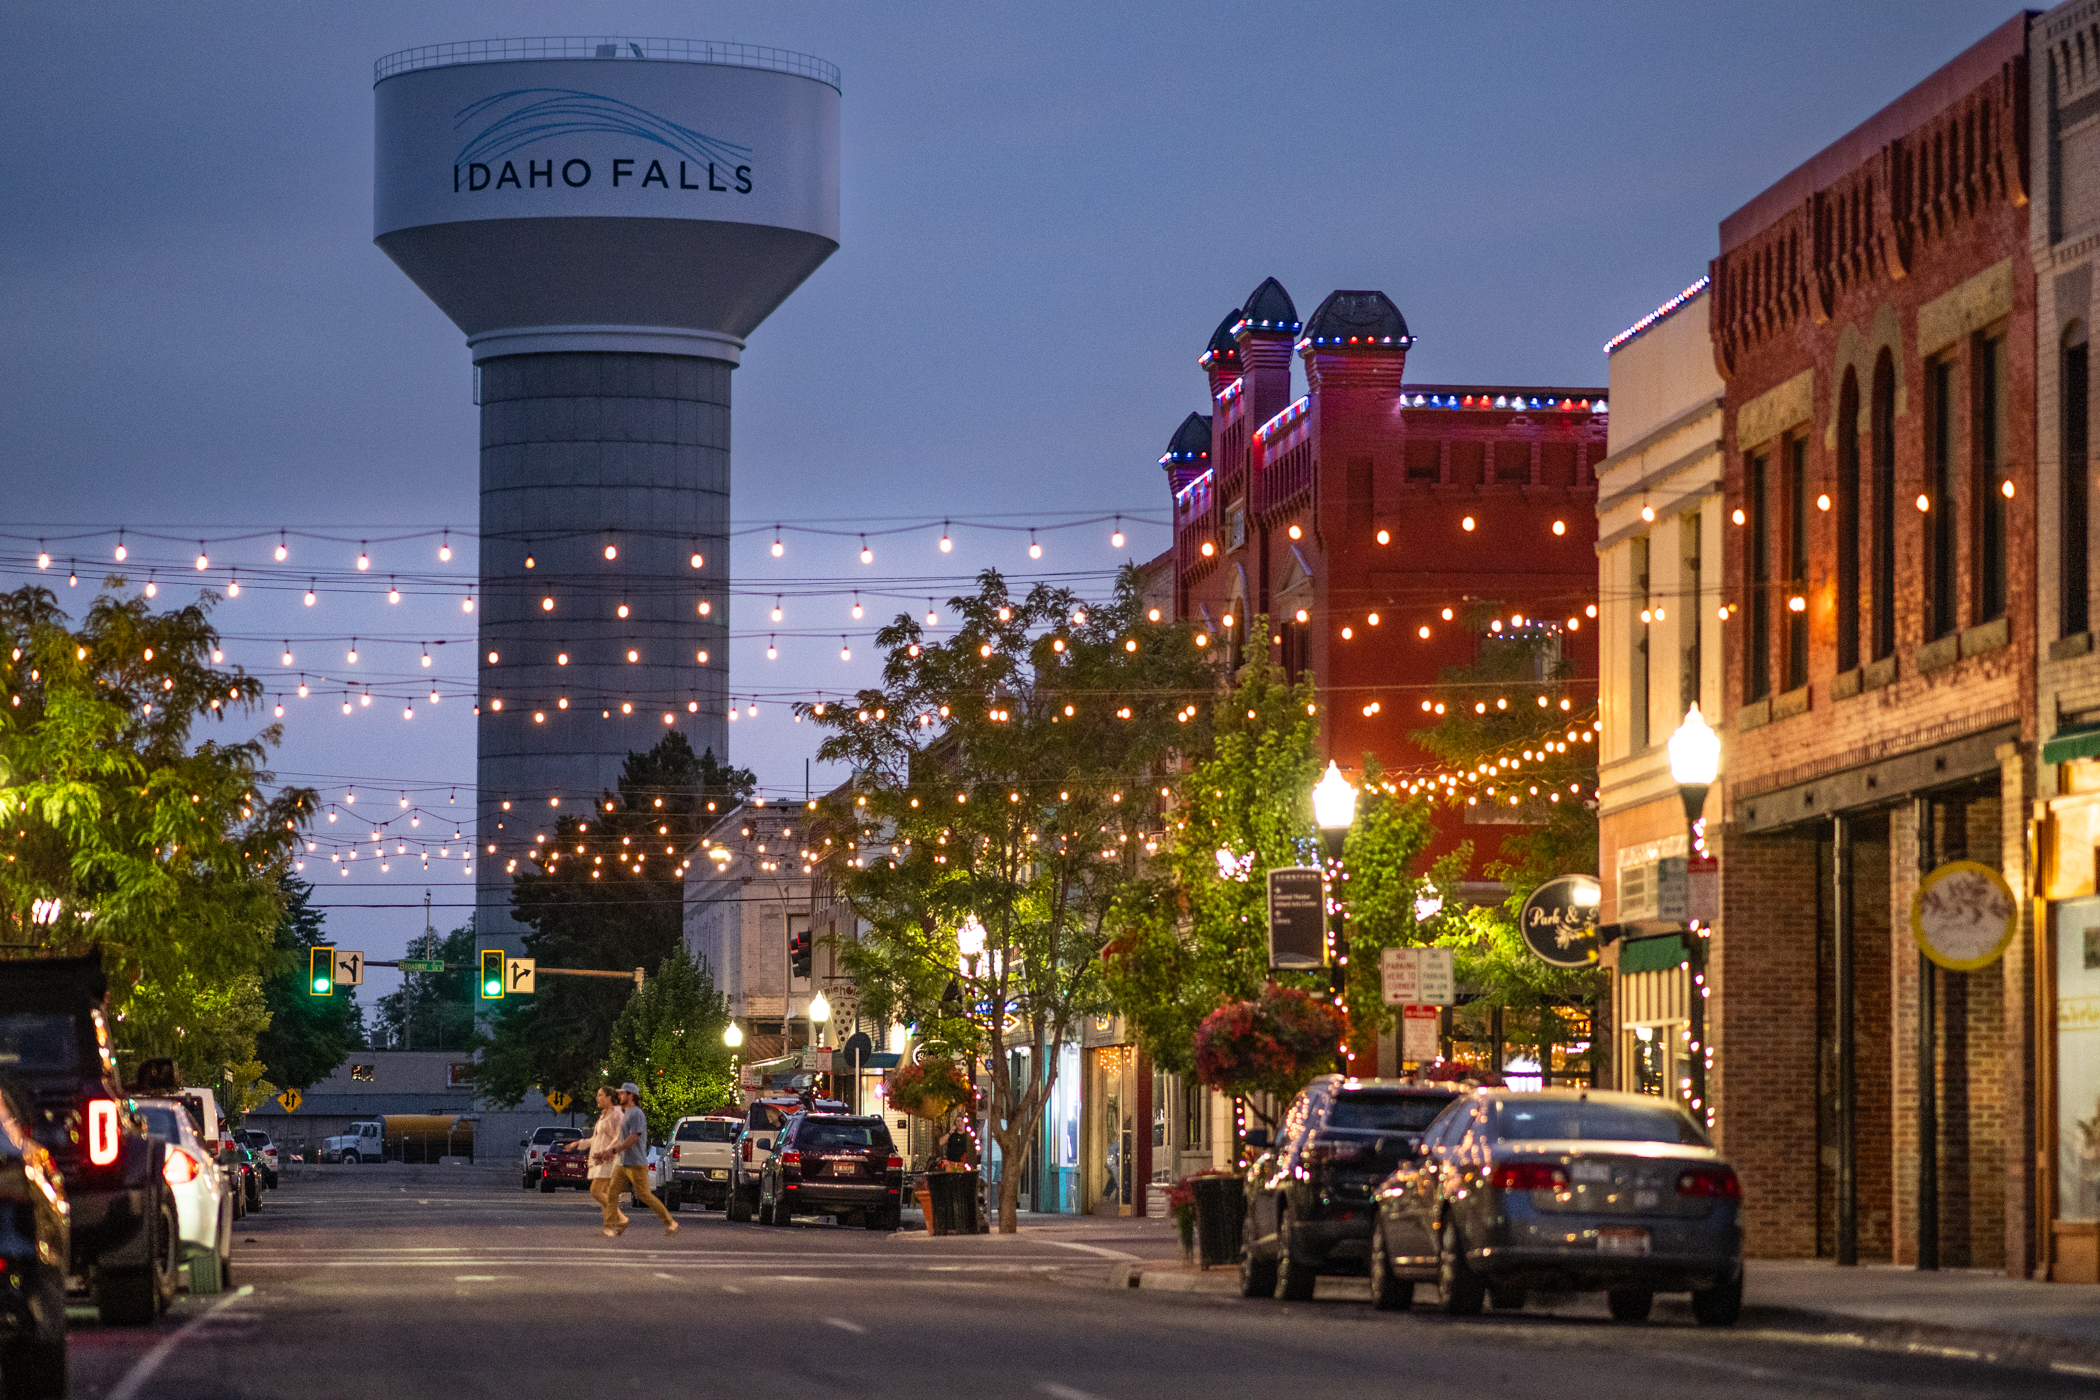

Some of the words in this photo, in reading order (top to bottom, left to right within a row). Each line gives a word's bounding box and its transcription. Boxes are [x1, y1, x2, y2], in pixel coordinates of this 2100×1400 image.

[454, 158, 591, 193] IDAHO
[613, 159, 752, 194] FALLS
[1528, 906, 1560, 928] Park
[1565, 905, 1579, 923] &
[1386, 962, 1416, 970] PARKING
[1387, 972, 1404, 980] HERE
[1408, 972, 1416, 980] TO
